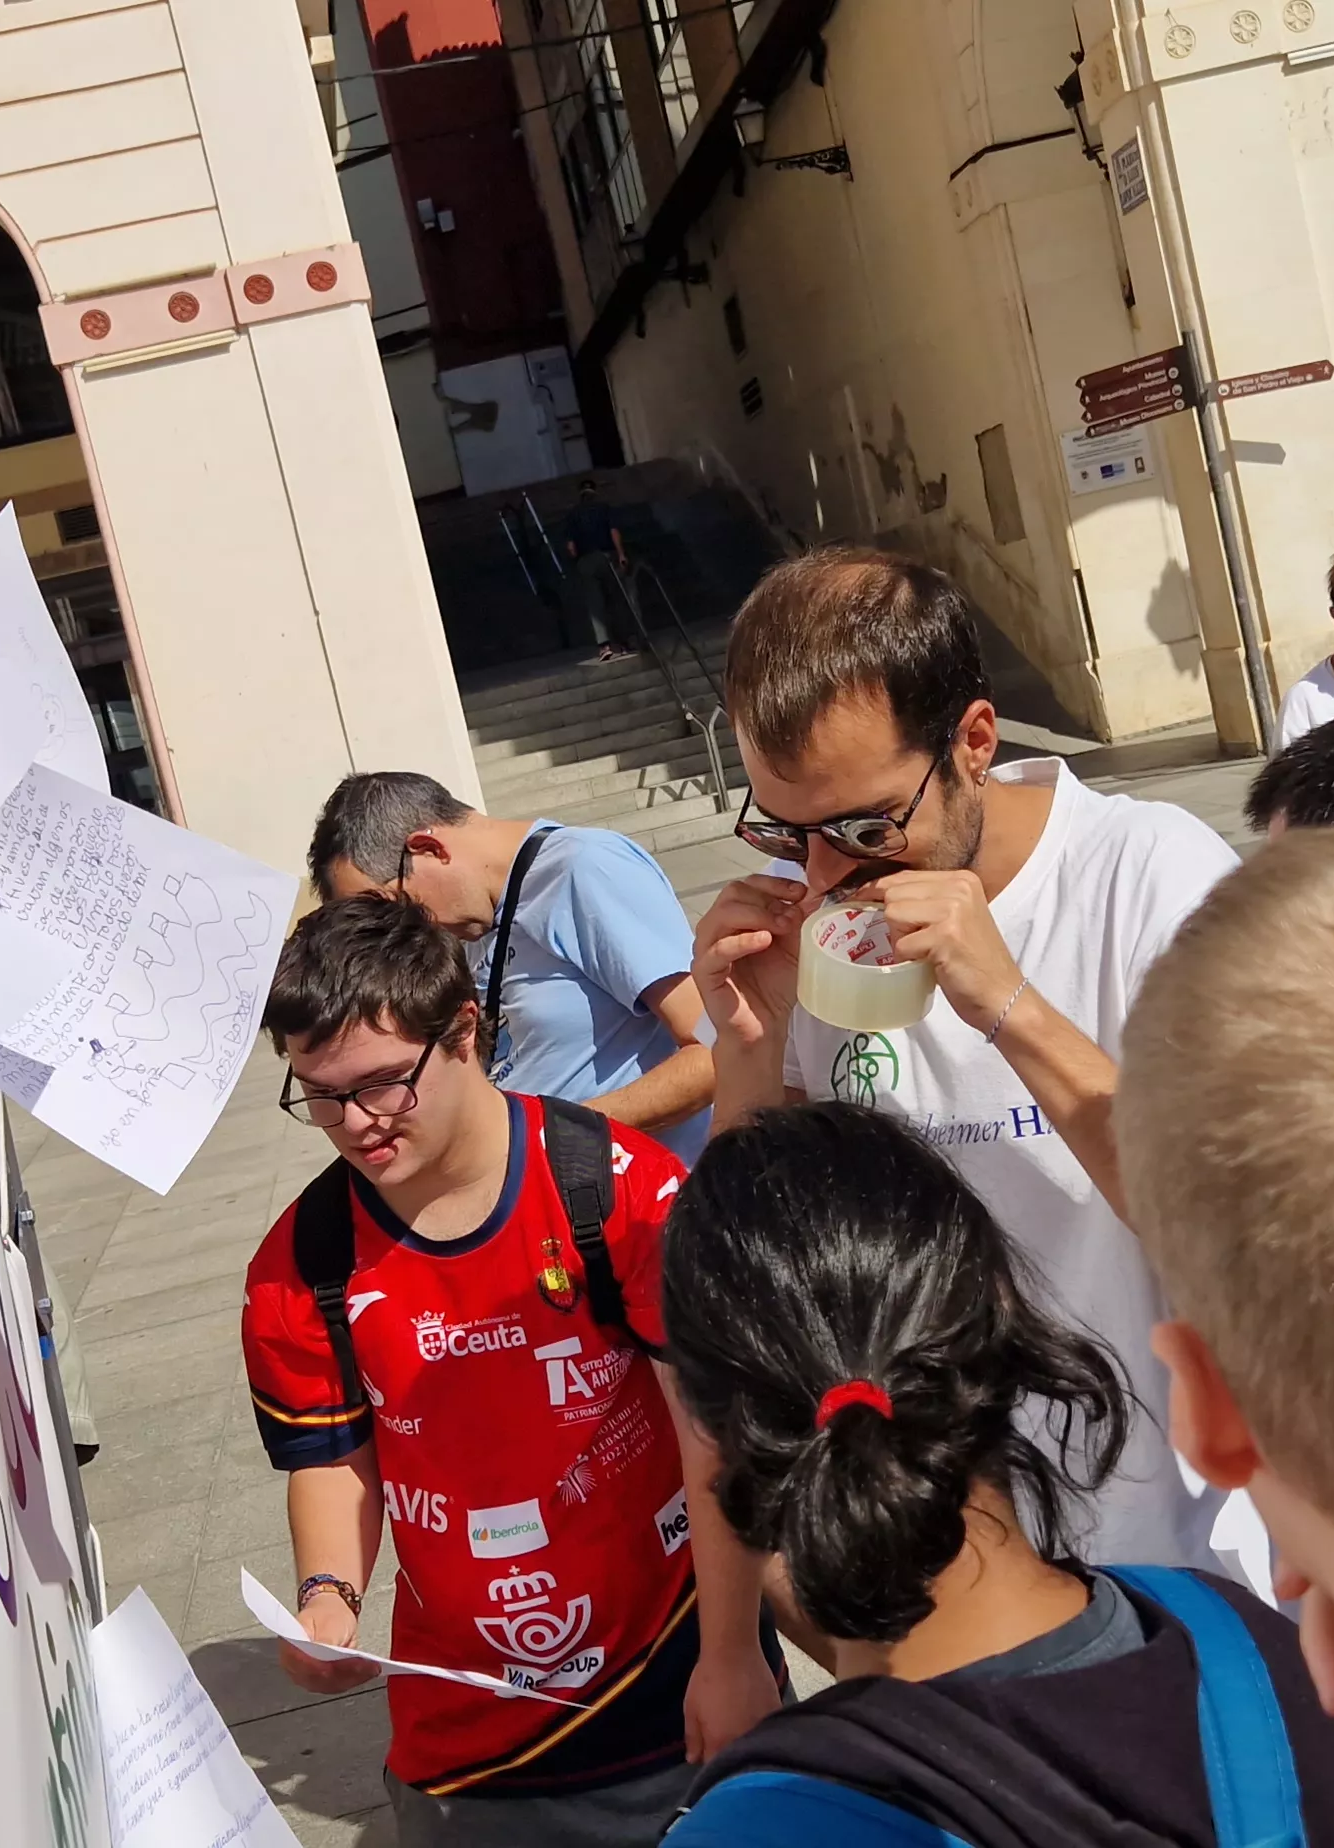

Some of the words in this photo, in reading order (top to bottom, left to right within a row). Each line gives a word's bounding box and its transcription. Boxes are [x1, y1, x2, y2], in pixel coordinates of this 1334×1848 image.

[1144, 389, 1171, 403] Catedral
[1243, 384, 1257, 393] San
[1258, 380, 1279, 391] Pedro
[448, 1323, 528, 1357] Ceuta
[383, 1480, 449, 1533] AVIS
[490, 1520, 540, 1541] Iberdrola
